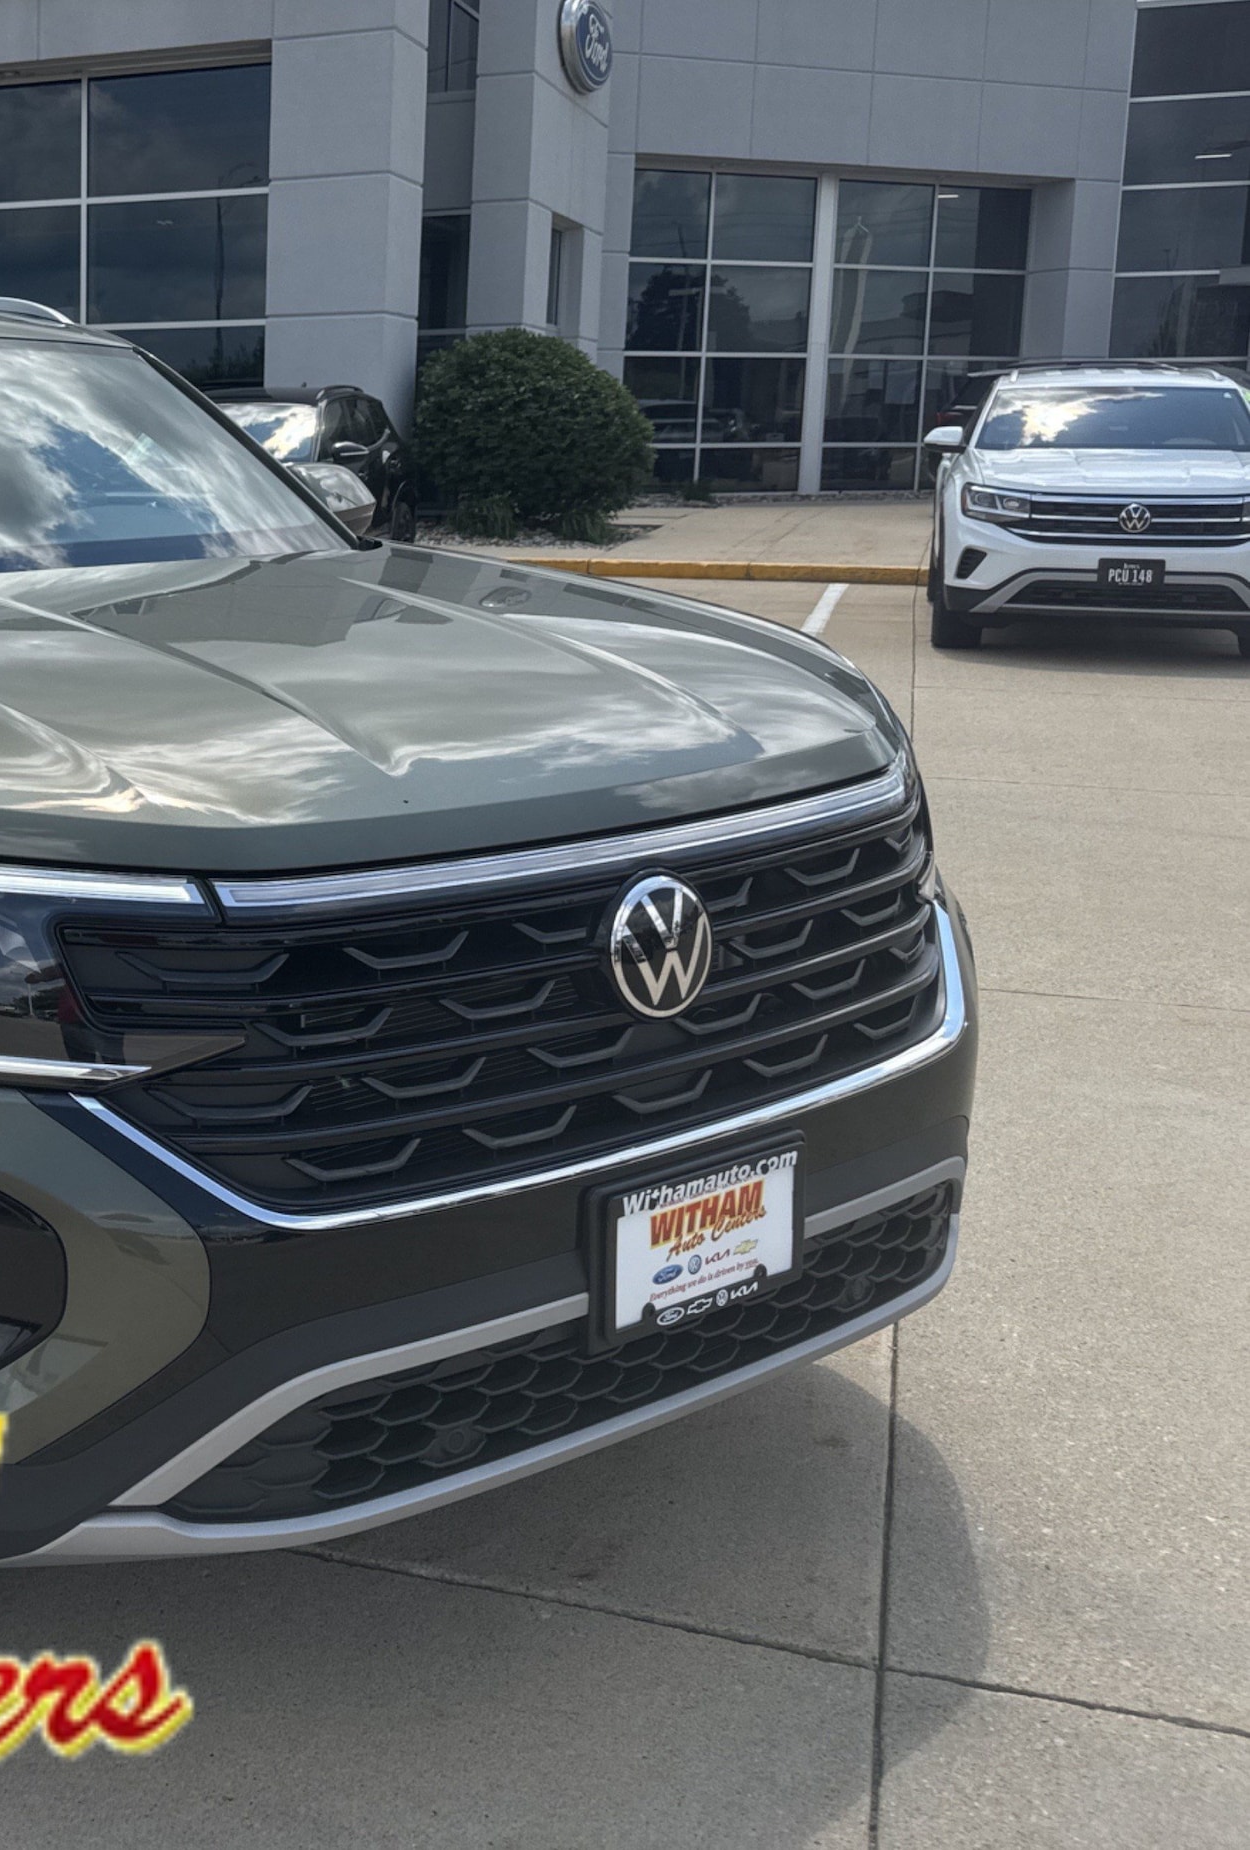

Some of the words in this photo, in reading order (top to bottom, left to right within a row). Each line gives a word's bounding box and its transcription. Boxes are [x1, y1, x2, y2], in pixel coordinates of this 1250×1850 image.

[584, 13, 610, 73] Ford
[1108, 568, 1129, 583] PCU
[1132, 569, 1153, 584] 148
[623, 1150, 799, 1217] Withamauto.com
[650, 1179, 765, 1249] WITHAM
[666, 1229, 705, 1262] Auto
[711, 1204, 767, 1242] Centers
[650, 1283, 687, 1302] Everything
[687, 1279, 698, 1288] we
[698, 1275, 707, 1285] do
[714, 1265, 736, 1279] driven
[736, 1263, 745, 1273] by
[656, 1266, 680, 1284] Ford
